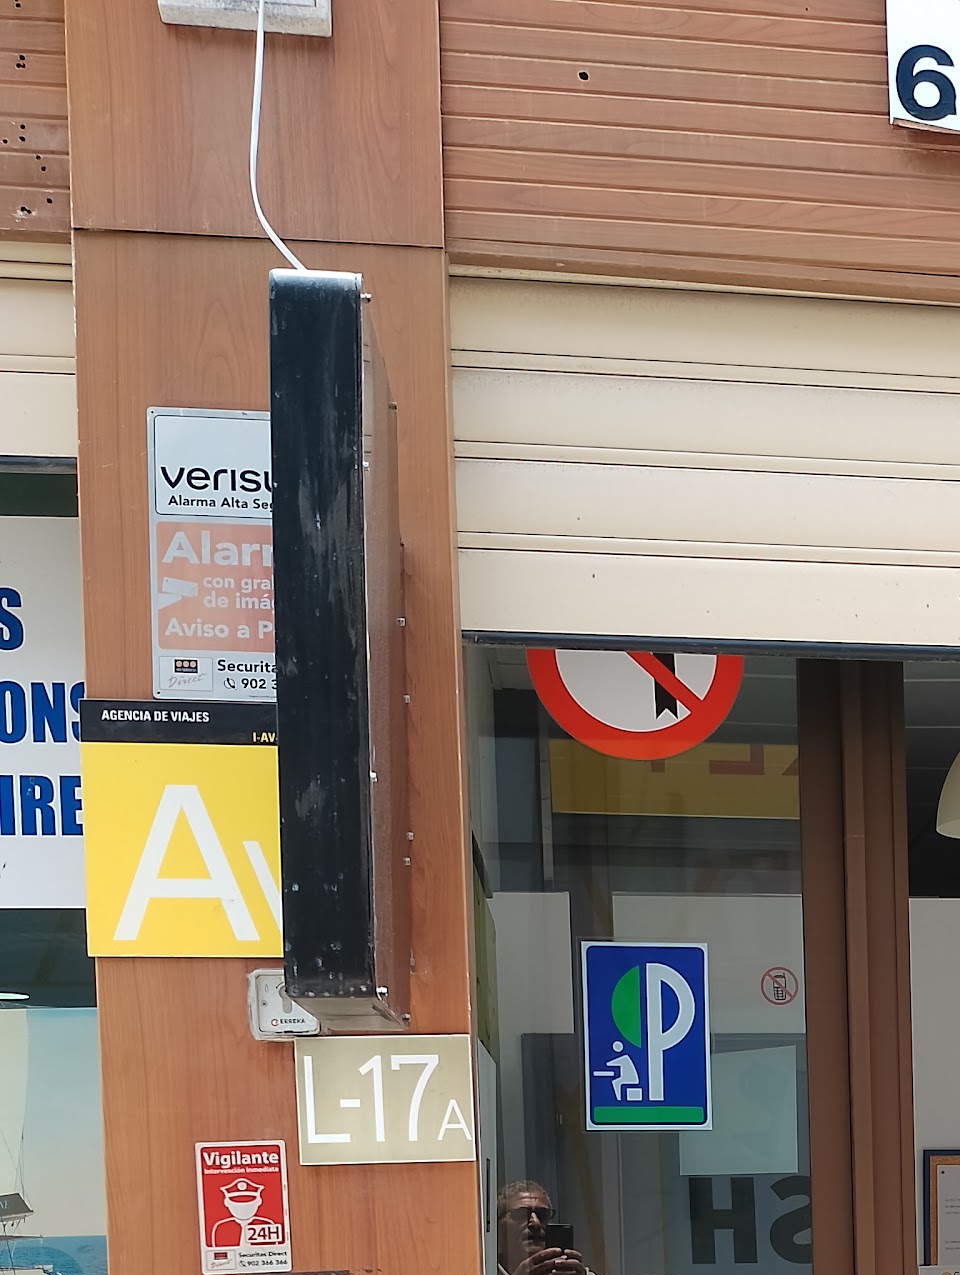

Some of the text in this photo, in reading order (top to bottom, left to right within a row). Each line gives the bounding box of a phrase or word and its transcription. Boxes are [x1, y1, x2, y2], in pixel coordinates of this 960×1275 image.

[168, 495, 216, 507] Alarma
[221, 496, 248, 509] Alta
[162, 530, 272, 567] Alar
[203, 575, 274, 593] con gra
[203, 591, 275, 615] de imá
[165, 618, 229, 638] Aviso
[237, 625, 250, 638] a
[241, 678, 267, 690] 902
[101, 709, 210, 723] AGENCIA DE VIAJES
[203, 1151, 279, 1168] Vigilante
[247, 1226, 279, 1240] 24H
